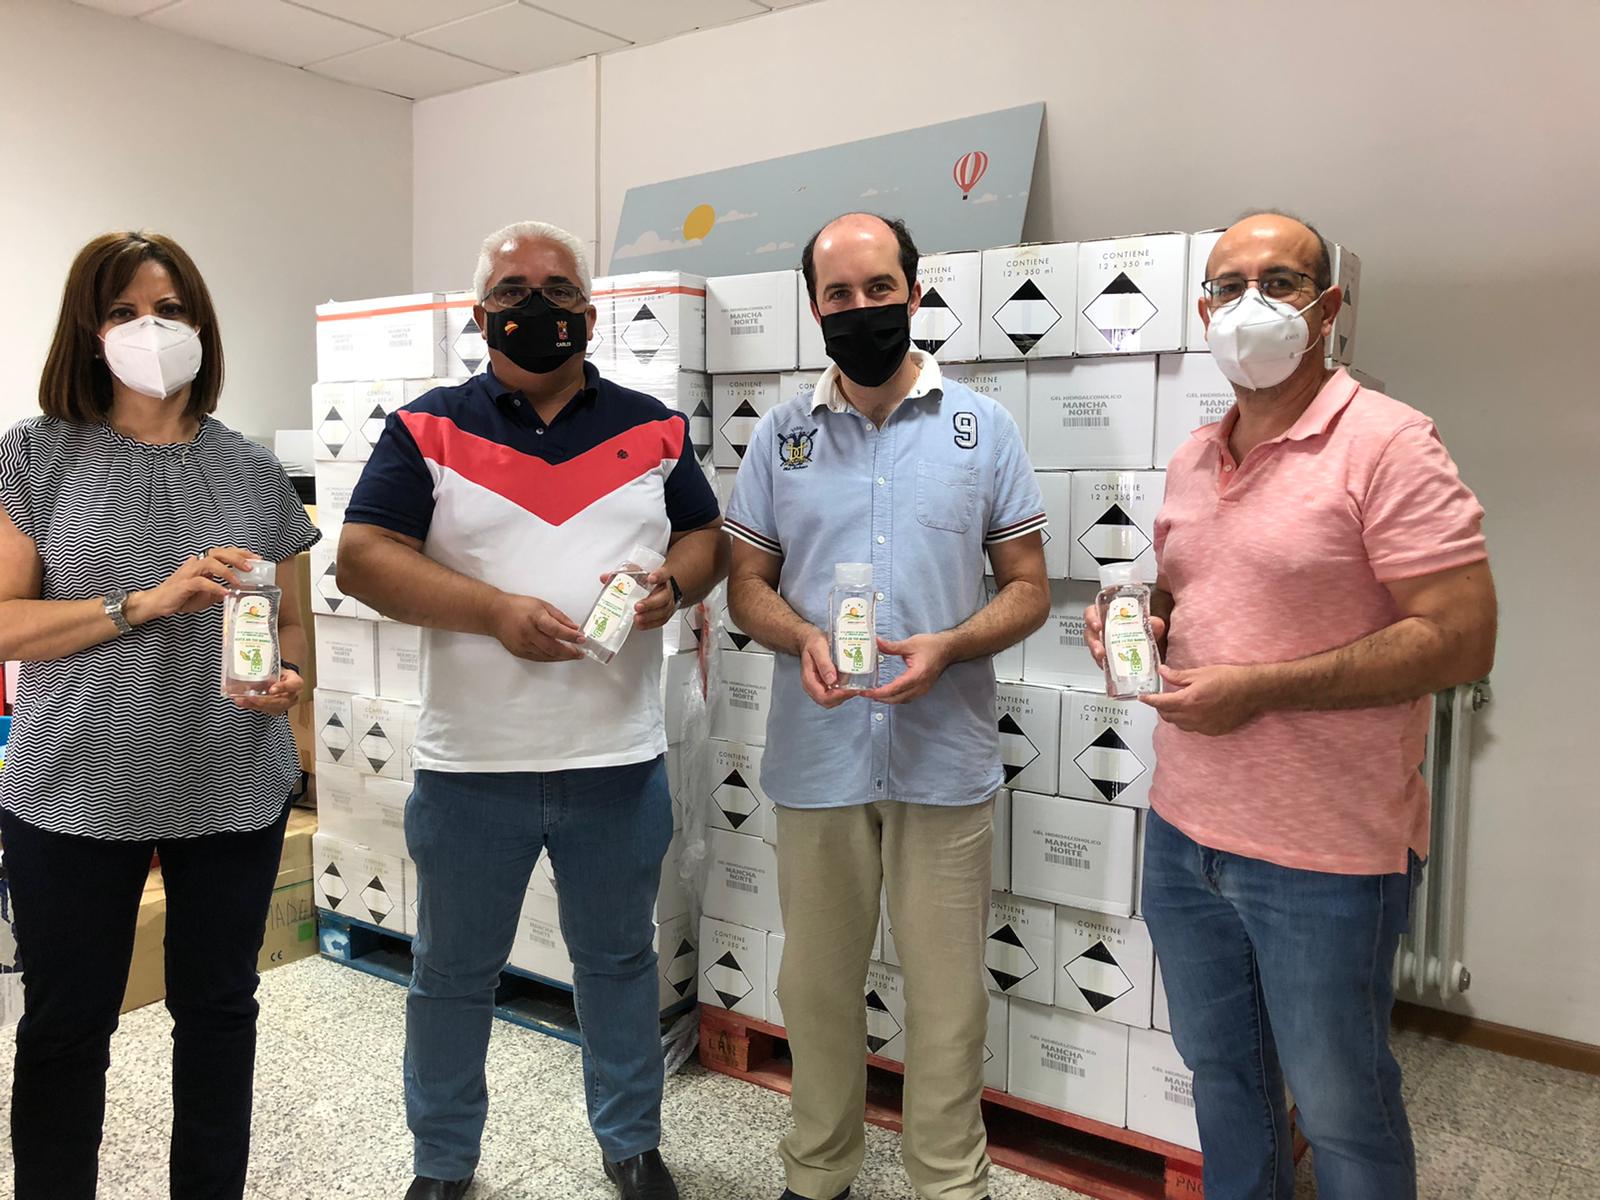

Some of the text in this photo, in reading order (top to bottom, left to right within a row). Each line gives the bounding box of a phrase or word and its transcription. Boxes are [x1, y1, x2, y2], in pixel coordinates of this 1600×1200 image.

[1101, 249, 1150, 261] CONTIENE
[1005, 257, 1050, 268] CONTIENE
[1098, 262, 1108, 270] 12
[1122, 260, 1140, 269] 350
[1144, 258, 1155, 267] ml
[917, 265, 953, 275] ONTIENE
[1002, 270, 1012, 278] 12
[1023, 267, 1041, 276] 350
[1044, 266, 1054, 274] ml
[928, 276, 945, 284] 350
[729, 311, 763, 320] MANCHA
[729, 381, 762, 389] CONTIENE
[957, 376, 998, 384] CONTIENE
[974, 385, 990, 393] 350
[1062, 401, 1108, 409] MANCHA
[1199, 400, 1232, 408] MANC
[1068, 408, 1103, 416] NORTE
[1205, 407, 1230, 415] NOR
[953, 411, 979, 450] 9
[1059, 620, 1089, 629] MANC
[729, 686, 758, 696] MANCHA
[732, 692, 754, 701] NORTE
[996, 694, 1030, 706] ONTIENE
[1006, 704, 1022, 714] 350
[1082, 703, 1129, 717] CONTIENE
[1080, 713, 1090, 721] 12
[1102, 716, 1120, 726] 350
[1122, 718, 1134, 727] ml
[718, 751, 750, 762] CONTIENE
[732, 760, 744, 768] 350
[1044, 837, 1089, 852] MANCHA
[1049, 845, 1084, 858] NORTE
[725, 866, 757, 879] MANCHA
[729, 873, 753, 884] NORTE
[990, 901, 1026, 916] ONTIENE
[1002, 911, 1018, 923] 350
[1020, 917, 1030, 926] ml
[1077, 919, 1123, 936] CONTIENE
[713, 929, 746, 944] CONTIENE
[1073, 928, 1084, 937] 12
[1096, 931, 1114, 943] 350
[1115, 937, 1127, 946] ml
[869, 970, 895, 983] NTIENE
[873, 980, 888, 990] 350
[1039, 1042, 1084, 1061] MANCHA
[1045, 1050, 1079, 1066] NORTE
[1163, 1075, 1193, 1089] MANC
[1169, 1084, 1193, 1096] NOR
